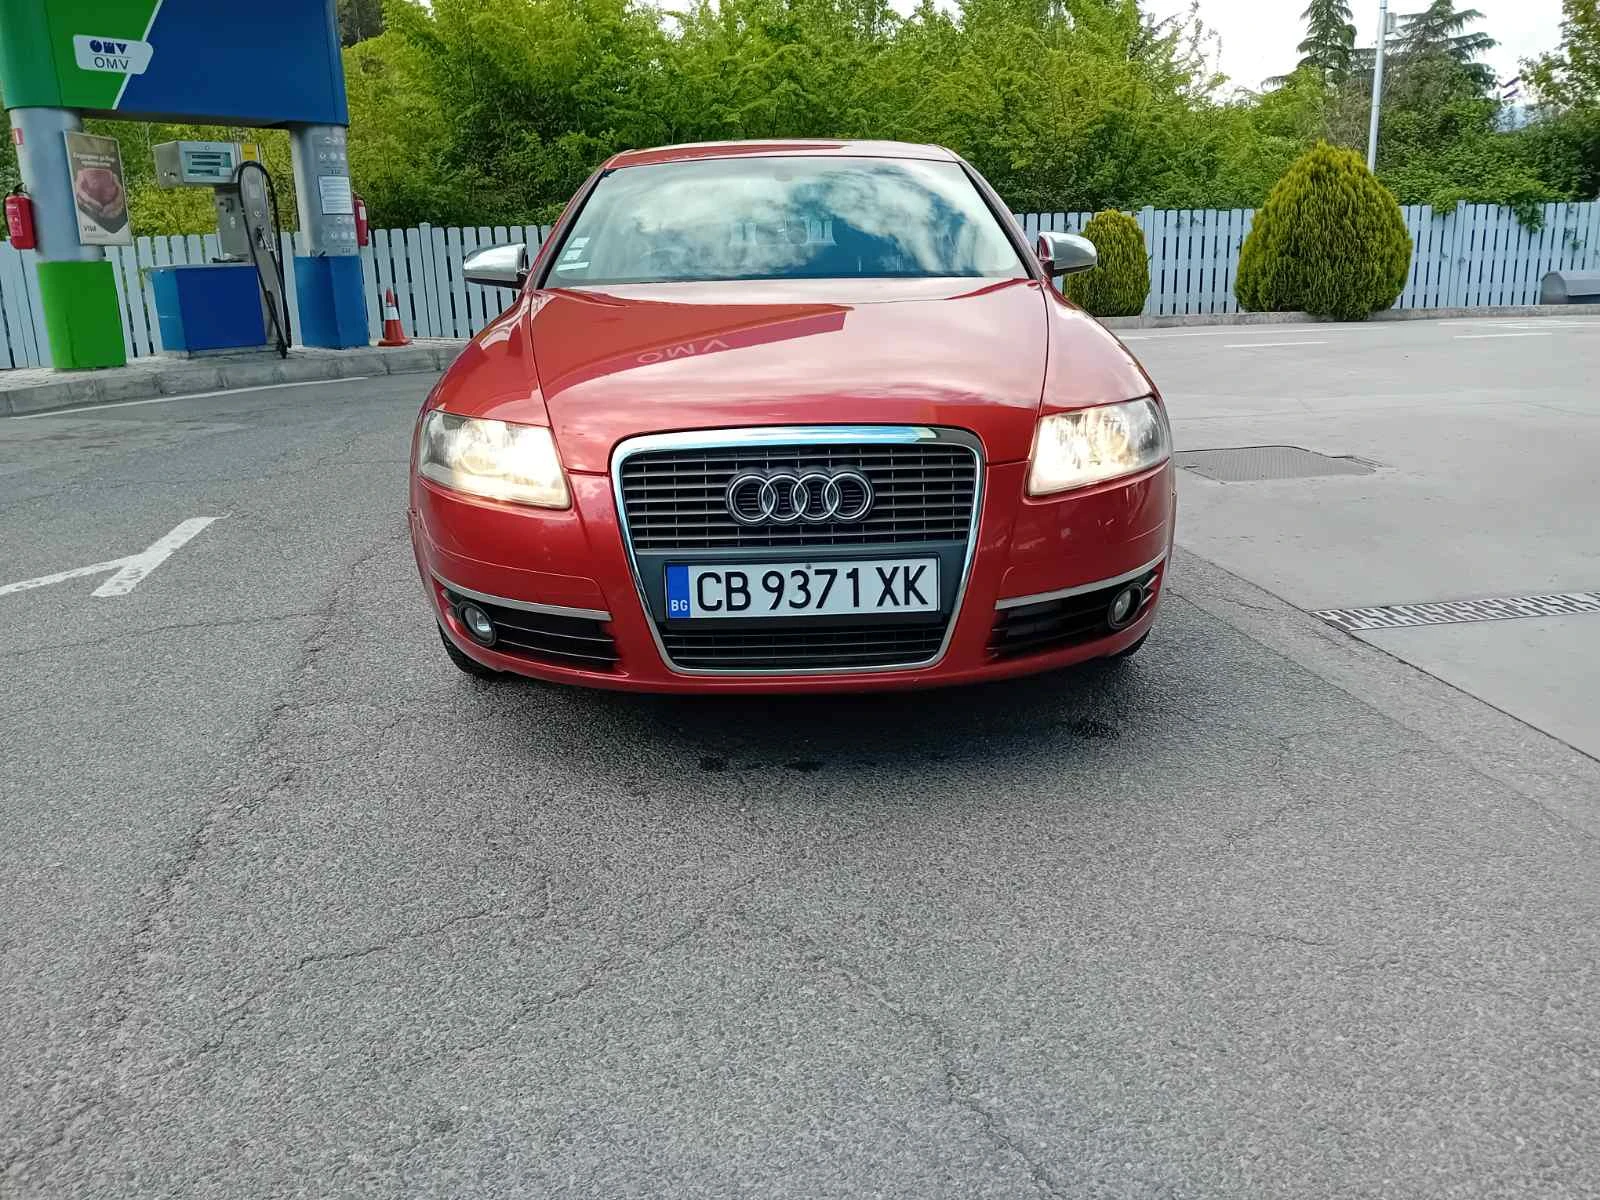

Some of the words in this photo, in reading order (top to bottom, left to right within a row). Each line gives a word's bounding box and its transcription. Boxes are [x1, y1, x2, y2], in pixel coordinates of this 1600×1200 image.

[89, 39, 128, 55] OMV
[94, 56, 129, 70] OMV
[696, 571, 751, 612] CB
[761, 567, 860, 610] 9371
[875, 565, 928, 608] XK
[671, 599, 689, 612] BG
